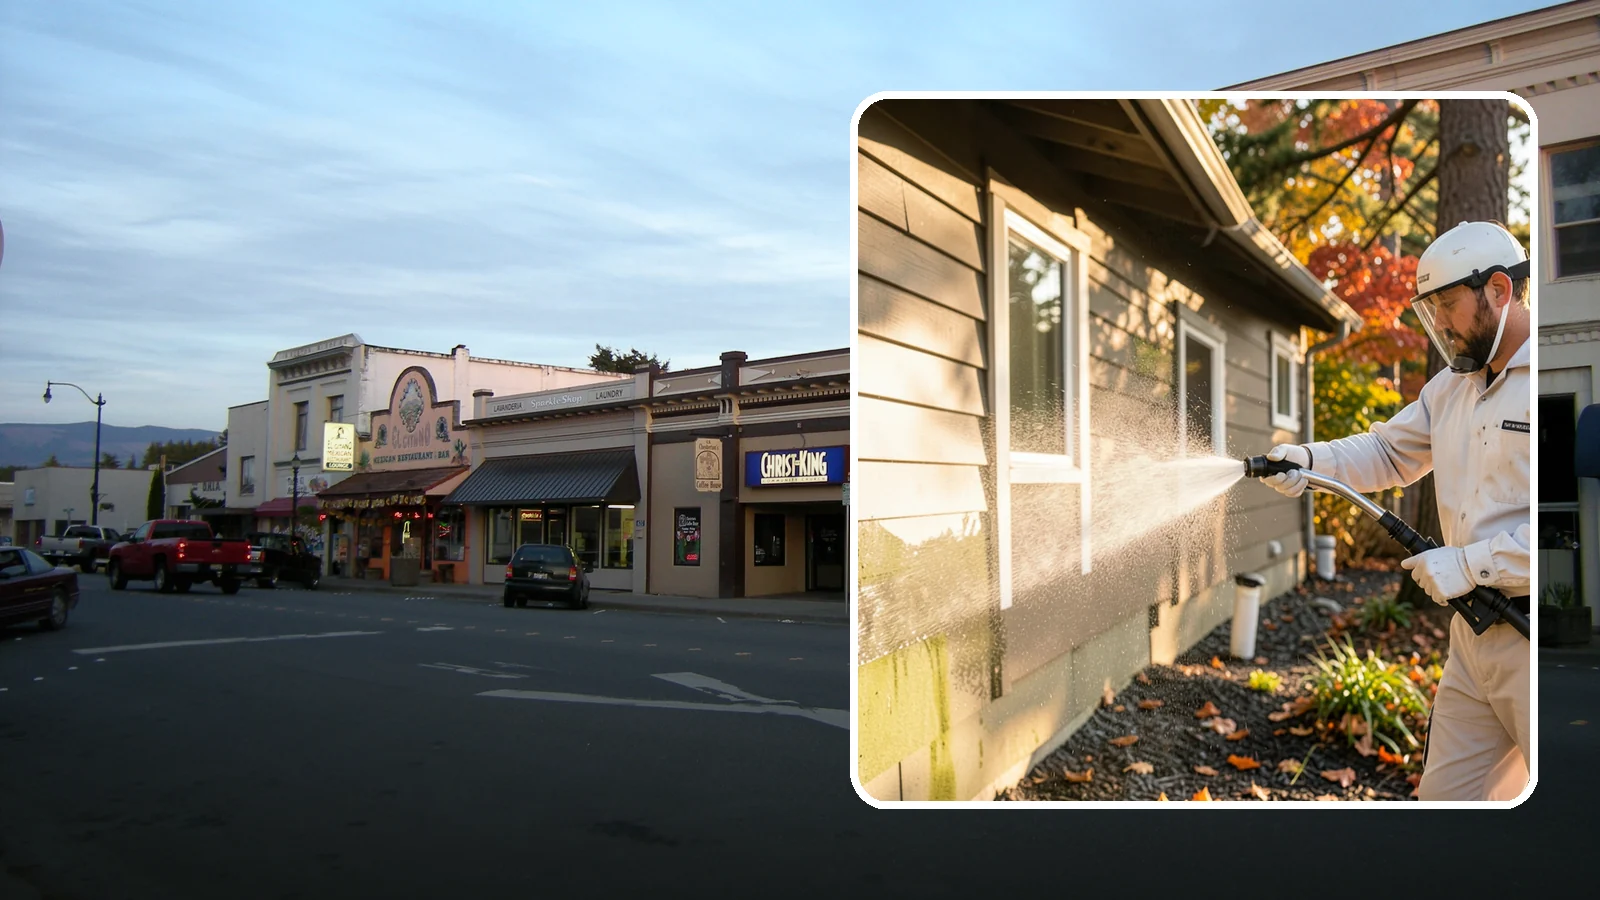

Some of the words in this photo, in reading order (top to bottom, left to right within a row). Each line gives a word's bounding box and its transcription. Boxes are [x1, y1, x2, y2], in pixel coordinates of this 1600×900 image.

[493, 401, 522, 412] LAVANDERIA
[531, 398, 559, 408] Sparkle
[562, 394, 582, 405] Shop
[595, 388, 623, 399] LAUNDRY
[374, 455, 396, 464] MEXICAN
[397, 451, 433, 462] RESTAURANT
[438, 450, 450, 459] BAR
[761, 452, 797, 478] CHRIST
[799, 450, 827, 476] KING
